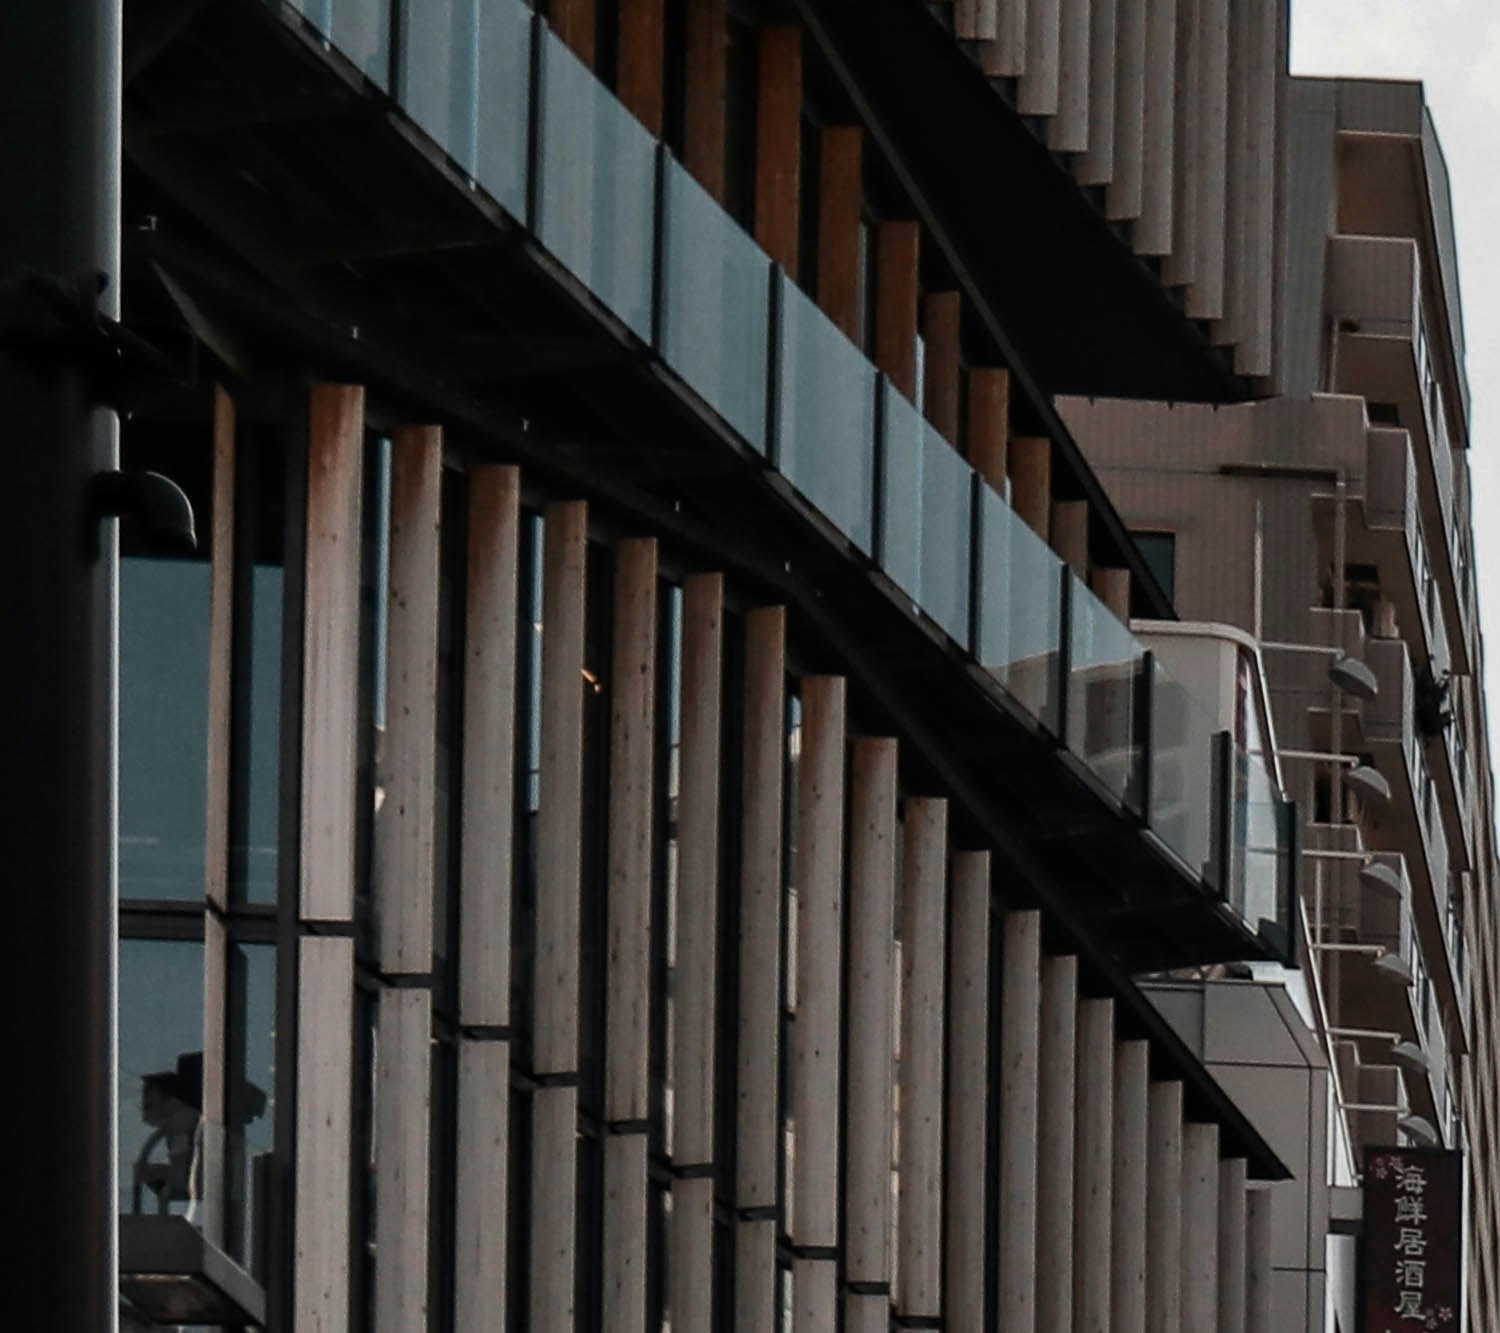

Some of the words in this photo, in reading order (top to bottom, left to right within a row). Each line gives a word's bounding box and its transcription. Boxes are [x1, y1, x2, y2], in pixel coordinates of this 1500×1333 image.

[1393, 1166, 1428, 1320] 海鮮居酒屋
